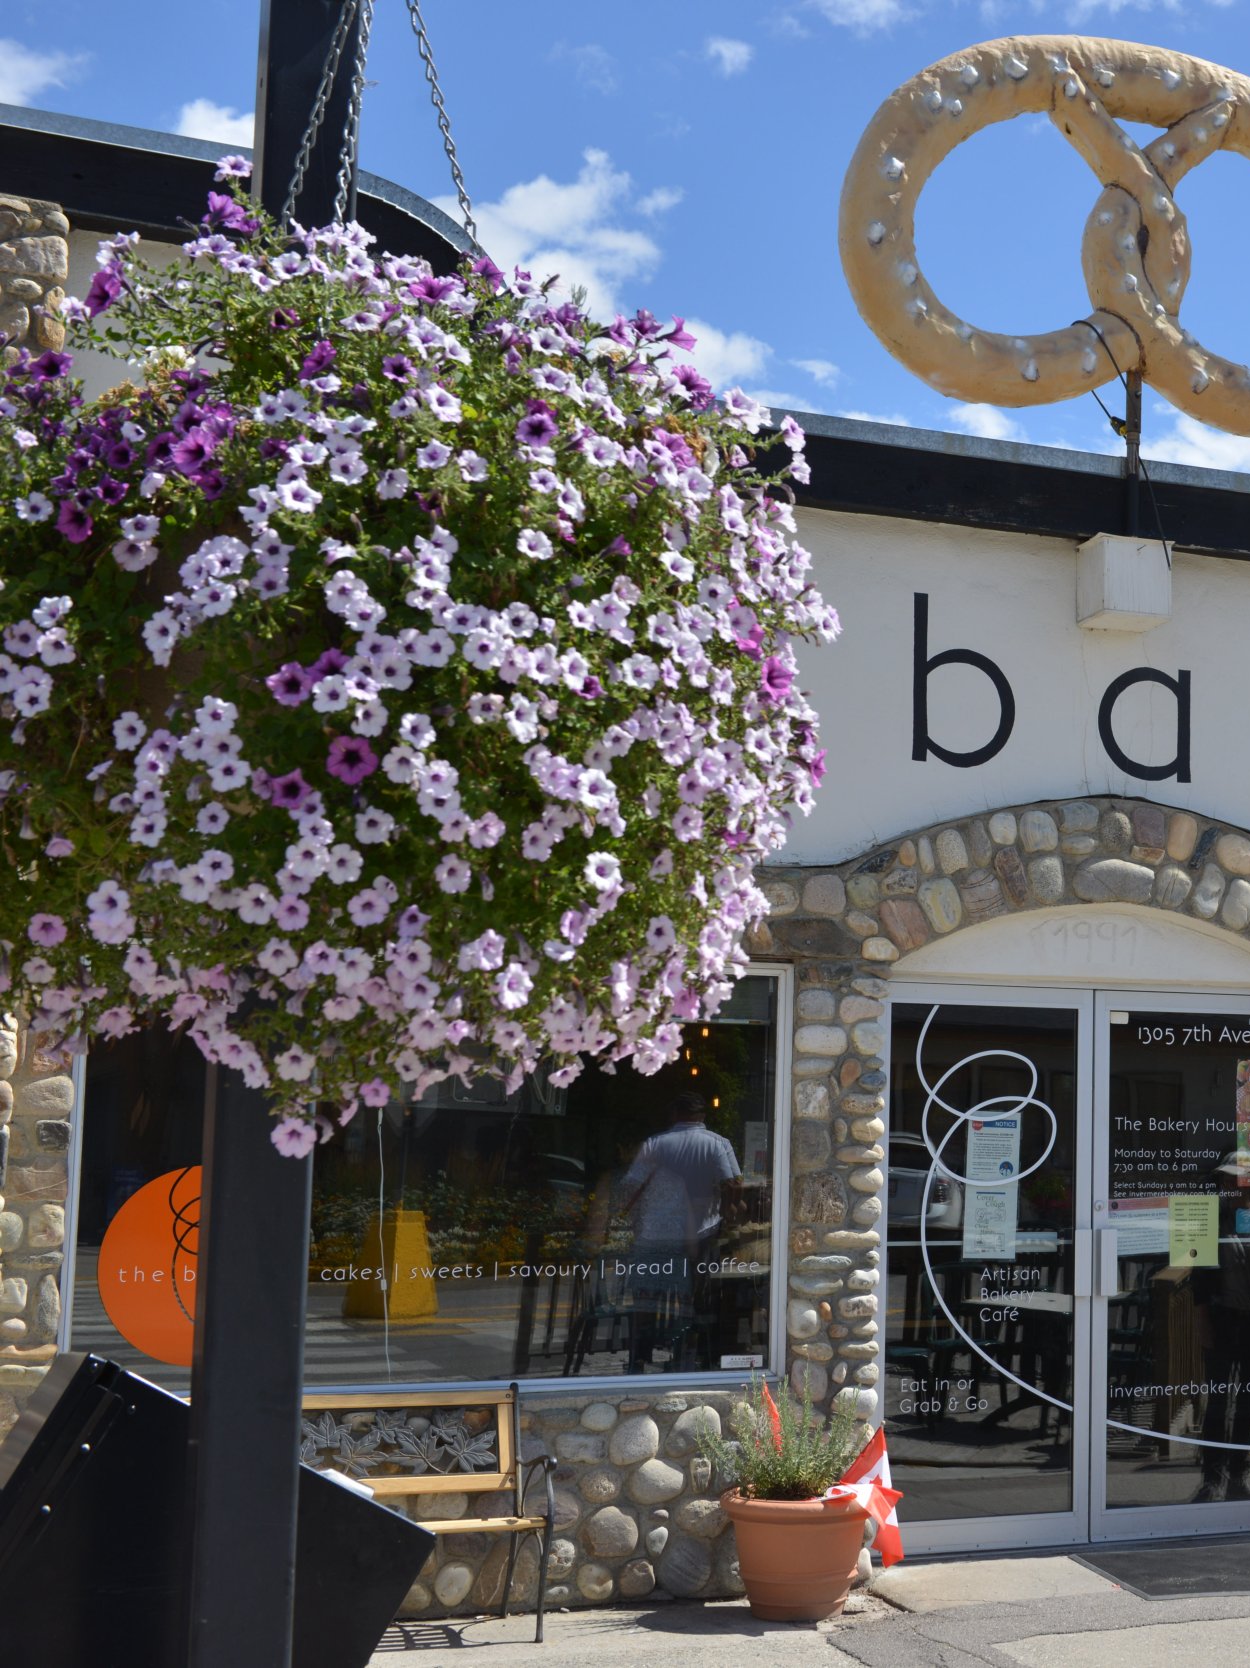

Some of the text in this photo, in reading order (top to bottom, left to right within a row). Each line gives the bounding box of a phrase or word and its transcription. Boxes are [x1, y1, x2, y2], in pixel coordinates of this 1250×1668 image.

[1138, 1026, 1175, 1045] 1305
[1182, 1024, 1212, 1046] 7th
[1115, 1116, 1248, 1134] The Bakery Hours
[1114, 1148, 1221, 1160] Monday to Saturday
[1113, 1161, 1198, 1173] 7:30 am to 6 pm
[1137, 1181, 1167, 1190] Sundays
[1219, 1190, 1242, 1198] details
[119, 1266, 164, 1282] the
[320, 1263, 383, 1281] cakes
[409, 1263, 483, 1279] sweets
[509, 1263, 591, 1280] savoury
[615, 1258, 673, 1276] bread
[696, 1257, 760, 1274] coffee
[980, 1267, 1040, 1281] Artisan
[980, 1286, 1035, 1305] Bakery
[980, 1306, 1019, 1322] Café
[901, 1377, 974, 1392] Eat in or
[900, 1396, 988, 1414] Grab & Go
